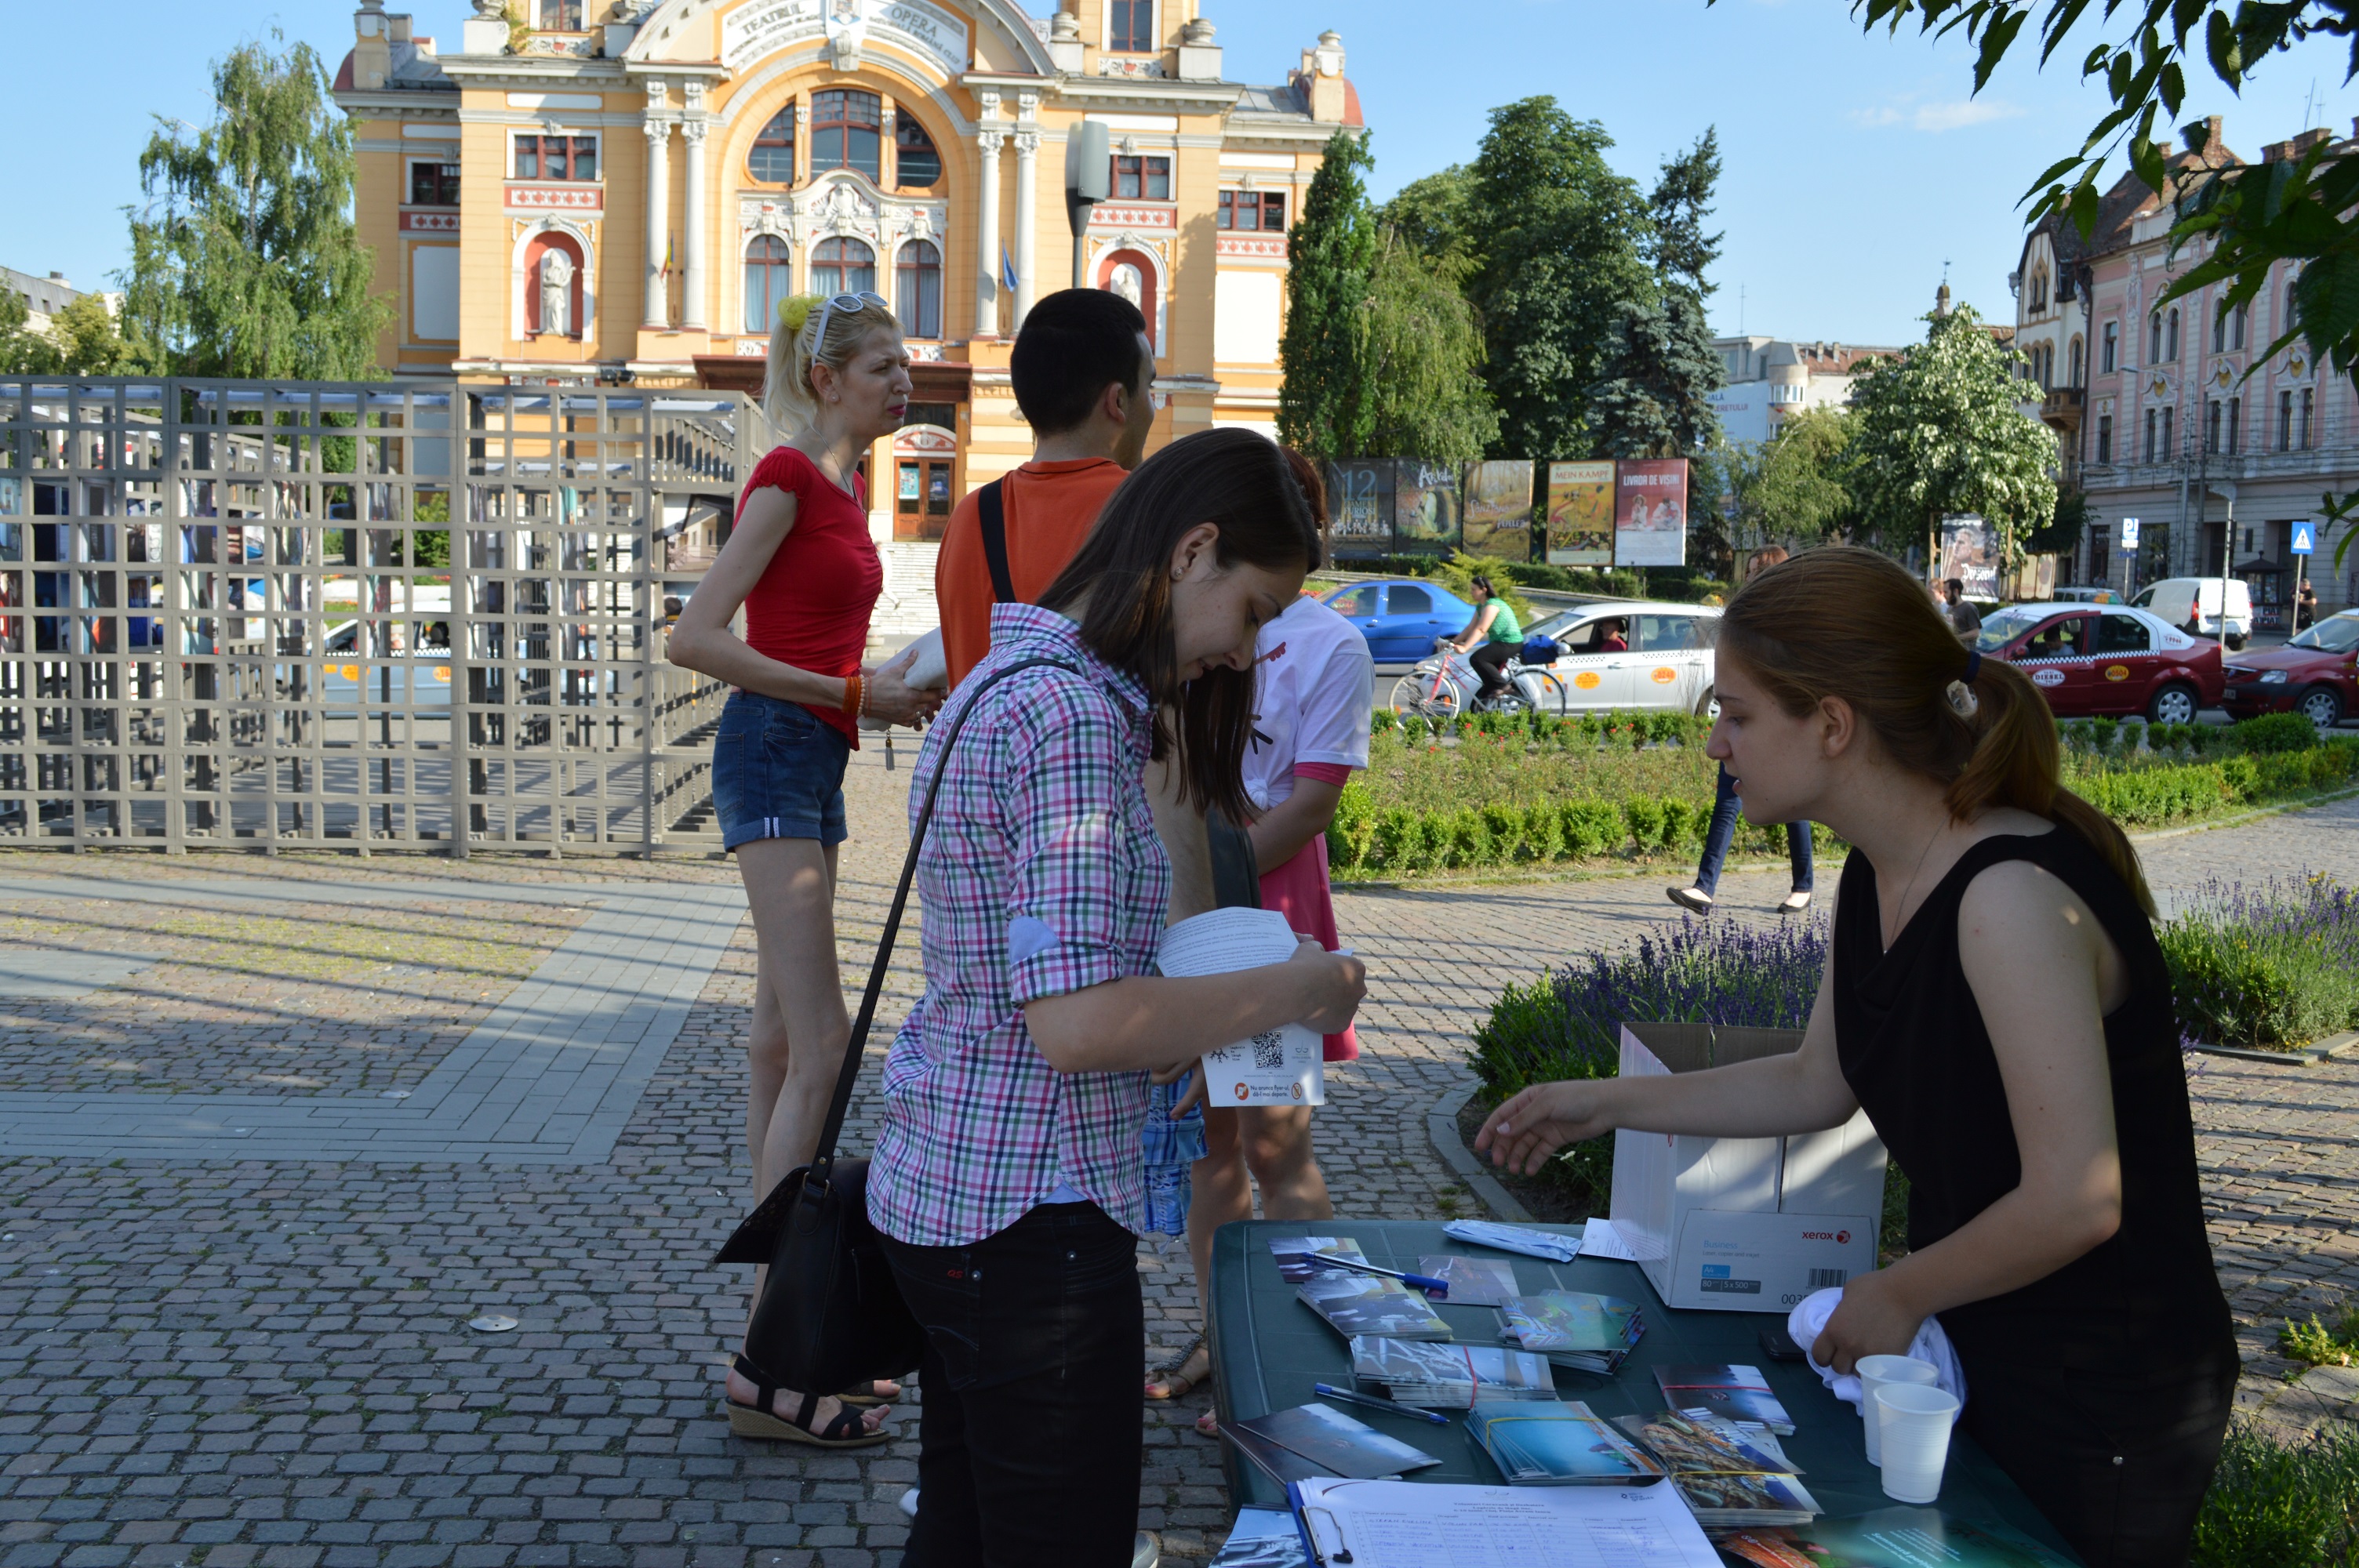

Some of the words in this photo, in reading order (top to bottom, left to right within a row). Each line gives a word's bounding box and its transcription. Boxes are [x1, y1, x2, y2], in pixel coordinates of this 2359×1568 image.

[740, 3, 805, 35] TEATRUL
[892, 7, 937, 37] OPERA
[1555, 471, 1577, 480] MEIN
[1579, 470, 1609, 479] KAMPF
[1623, 475, 1648, 486] LIVADA
[1649, 475, 1658, 485] DE
[1342, 470, 1376, 501] 12
[2111, 669, 2128, 677] 0504
[1703, 1240, 1738, 1249] Business
